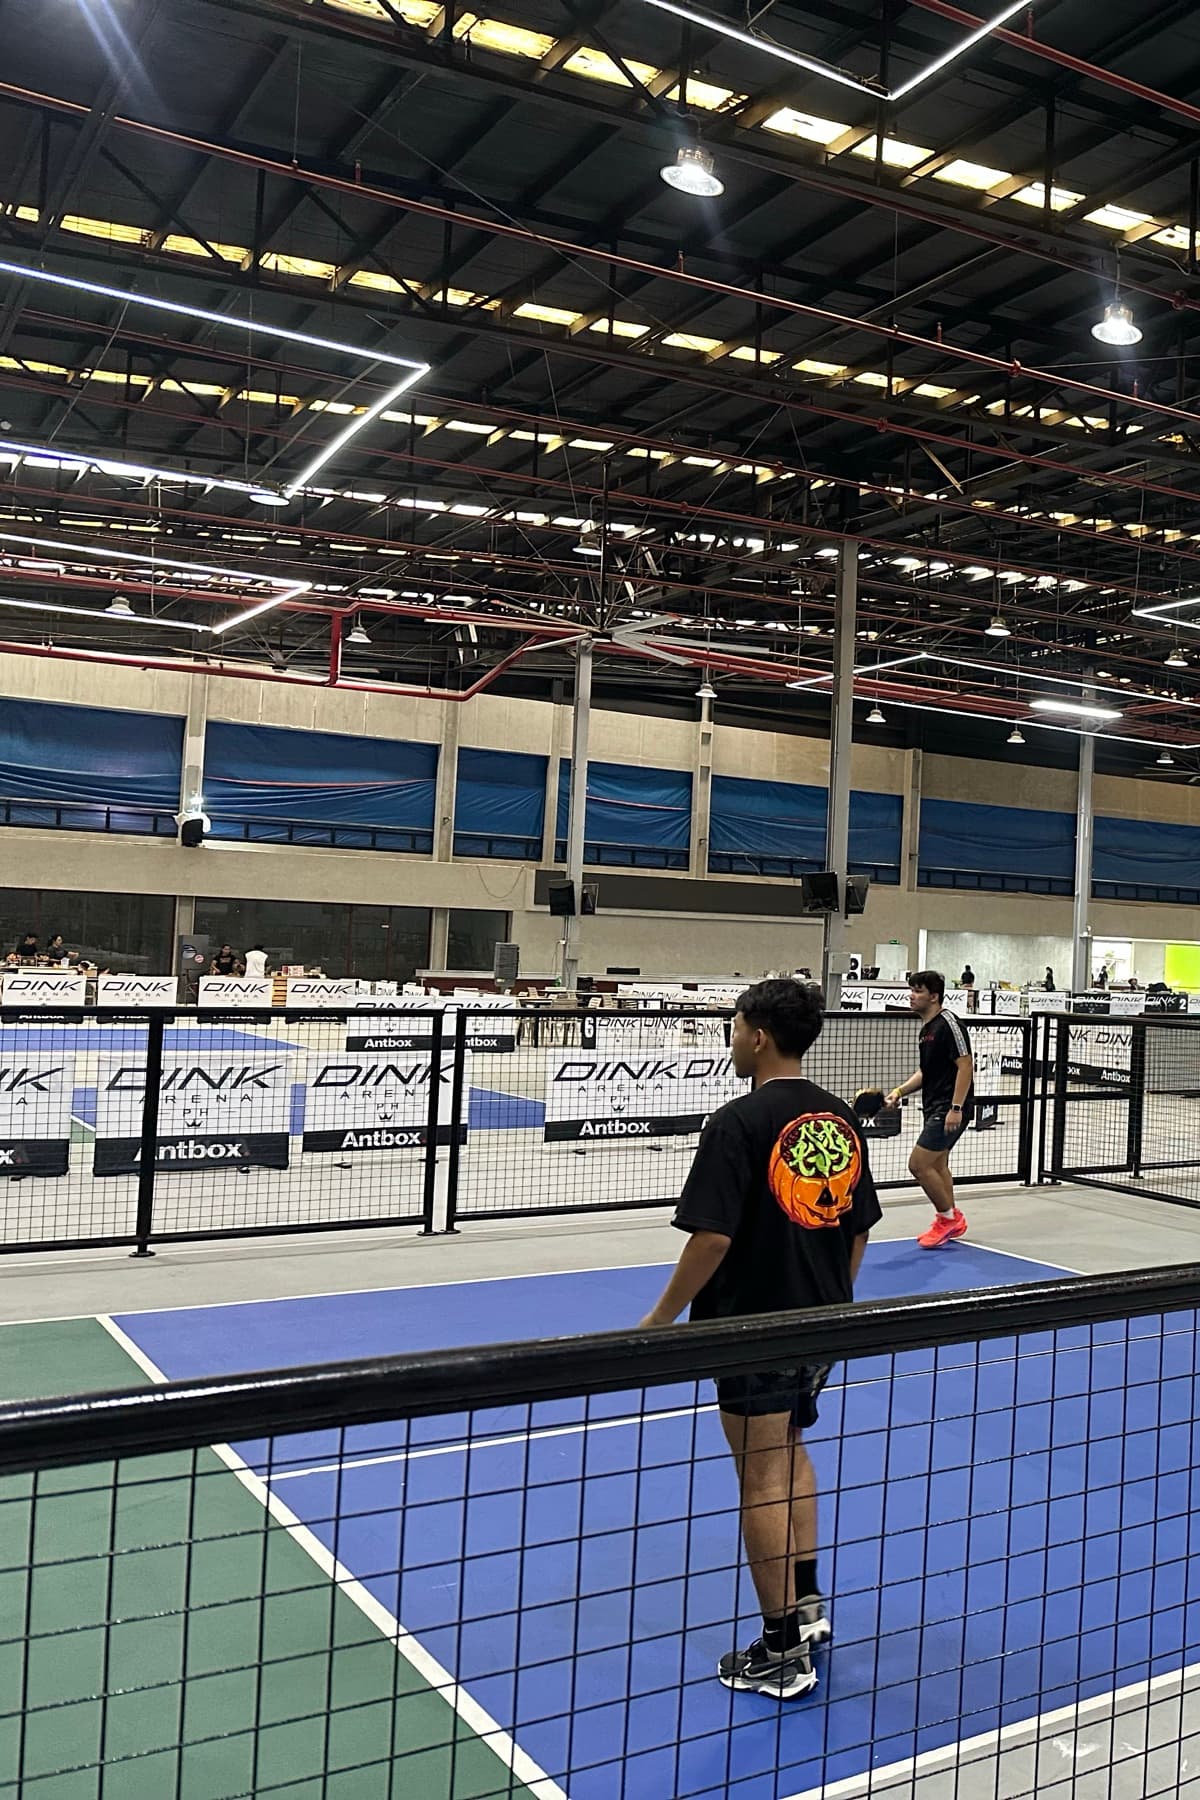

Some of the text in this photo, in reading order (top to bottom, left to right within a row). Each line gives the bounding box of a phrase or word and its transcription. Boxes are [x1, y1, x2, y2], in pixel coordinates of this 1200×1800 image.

[8, 981, 81, 991] DINK
[103, 982, 172, 992] DINK
[203, 983, 269, 993] DINK
[291, 984, 354, 994] DINK
[1180, 999, 1187, 1010] 2
[598, 1018, 639, 1028] DINK
[643, 1018, 680, 1030] DINK
[364, 1038, 412, 1048] Antbox
[453, 1037, 498, 1047] ntbox
[1096, 1031, 1133, 1047] DIN
[553, 1060, 678, 1082] DINK
[106, 1065, 284, 1090] DINK
[578, 1083, 664, 1092] ARENA
[611, 1095, 630, 1104] PH
[377, 1102, 399, 1110] PH
[183, 1107, 208, 1117] PH
[579, 1119, 650, 1136] Antbox
[342, 1130, 422, 1148] Antbox
